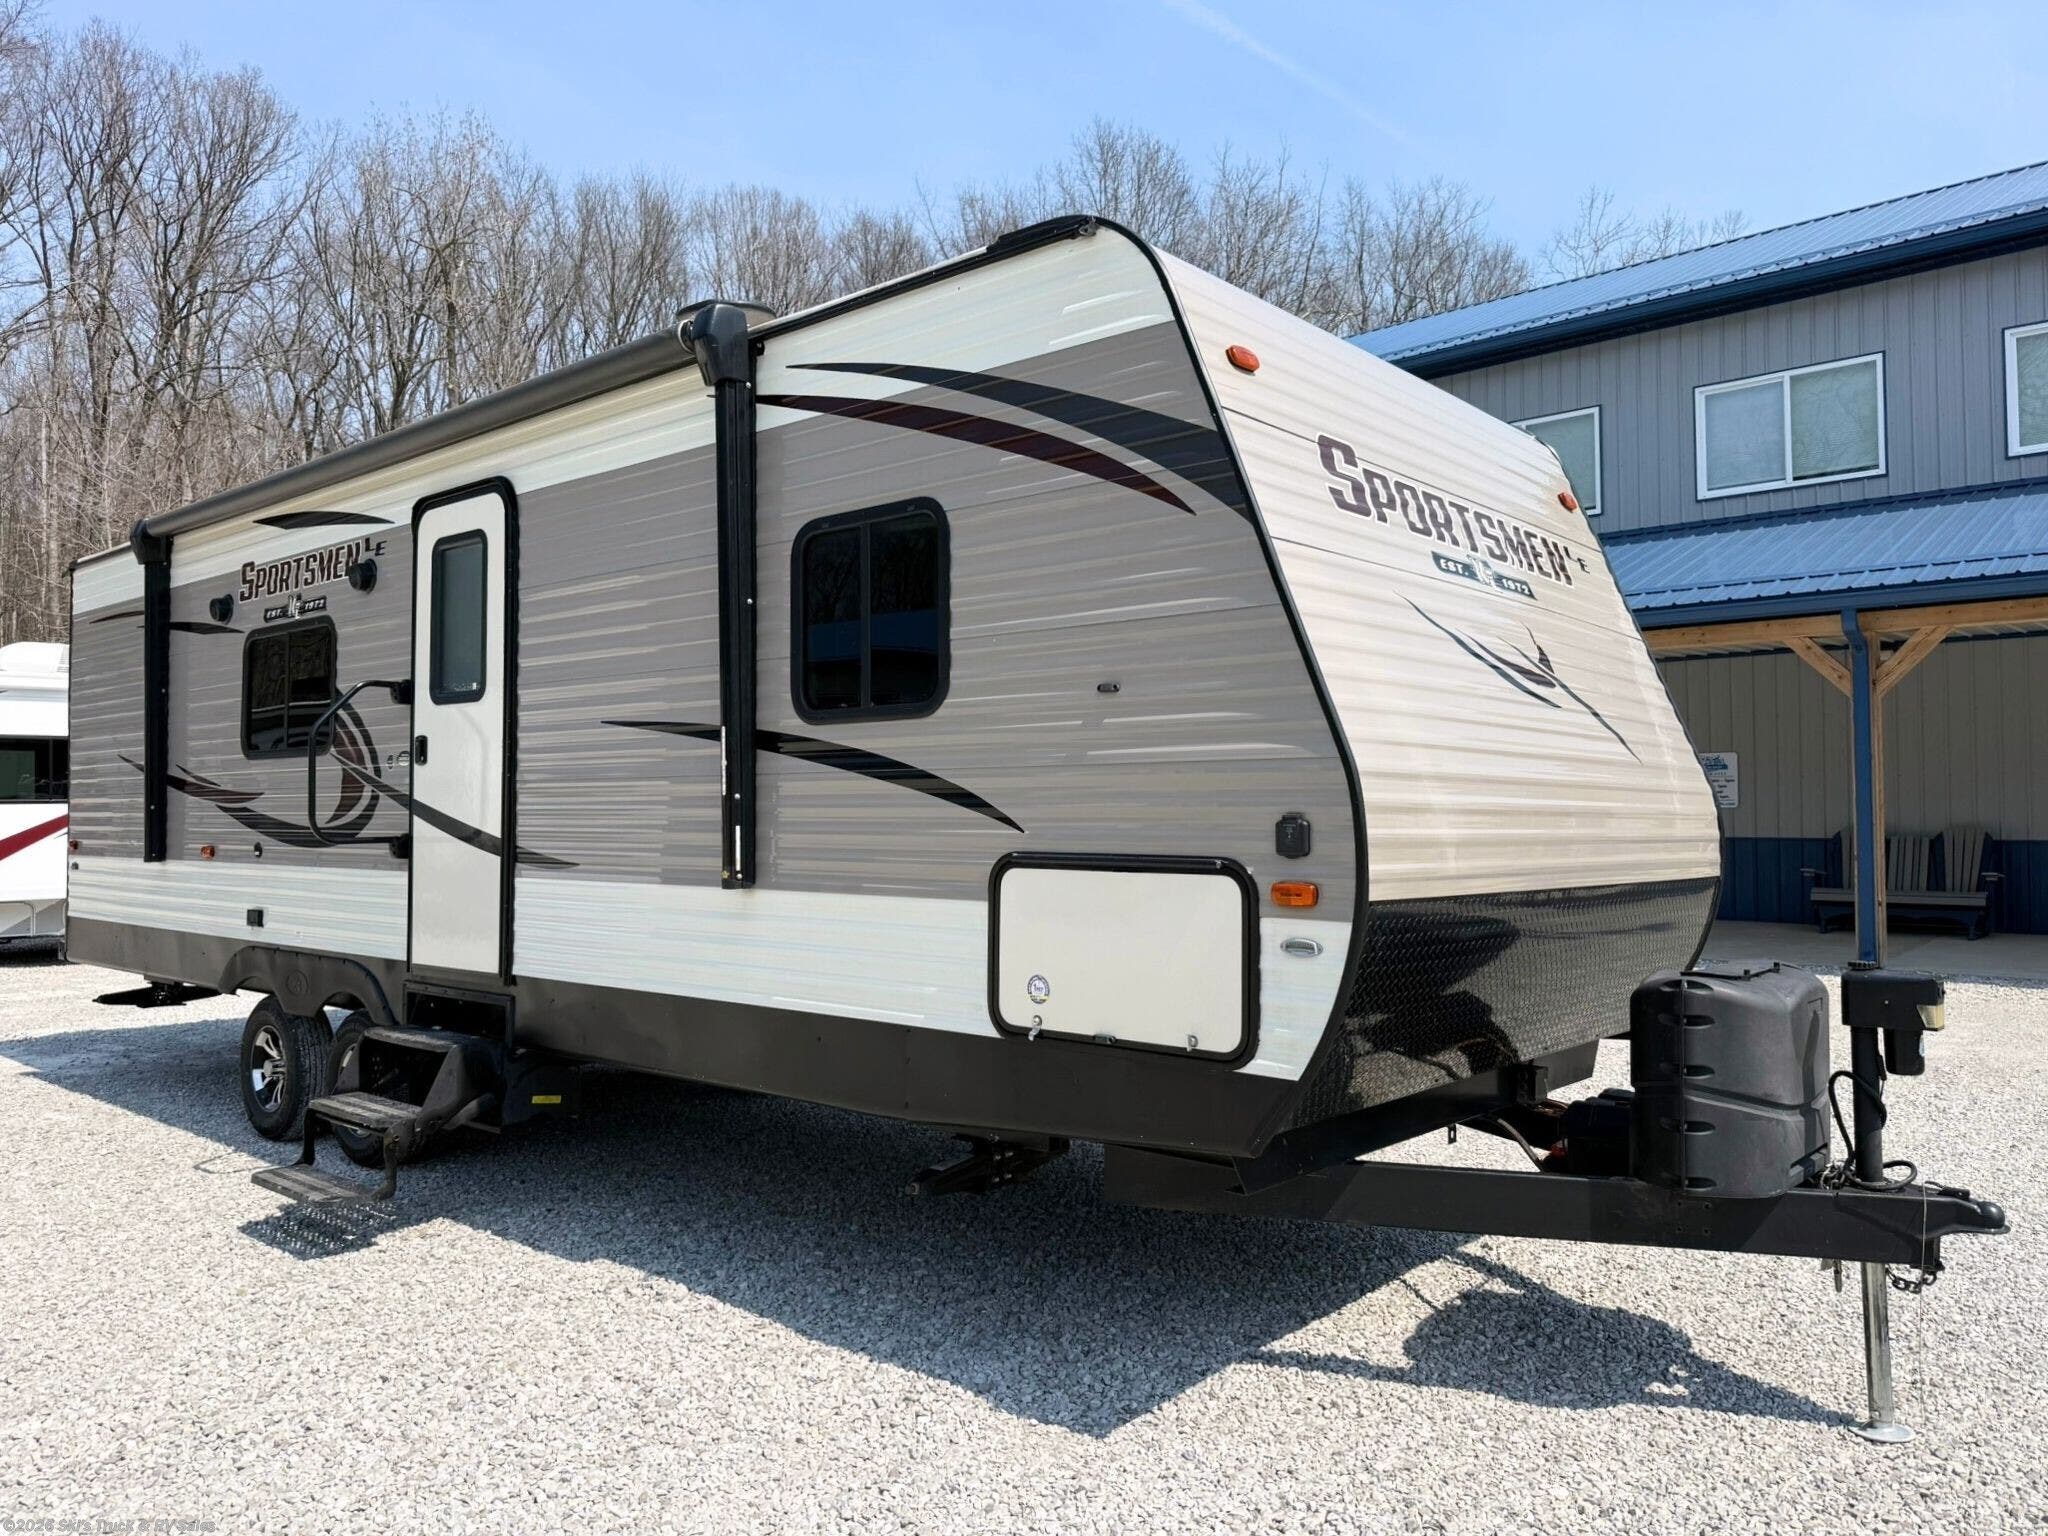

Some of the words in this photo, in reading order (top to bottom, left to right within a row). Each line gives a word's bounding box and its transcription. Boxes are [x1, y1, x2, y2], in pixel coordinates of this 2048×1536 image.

[1317, 434, 1573, 585] SPORTSMEN
[364, 537, 388, 556] LE
[1439, 557, 1470, 577] EST.
[1501, 578, 1530, 596] 1972
